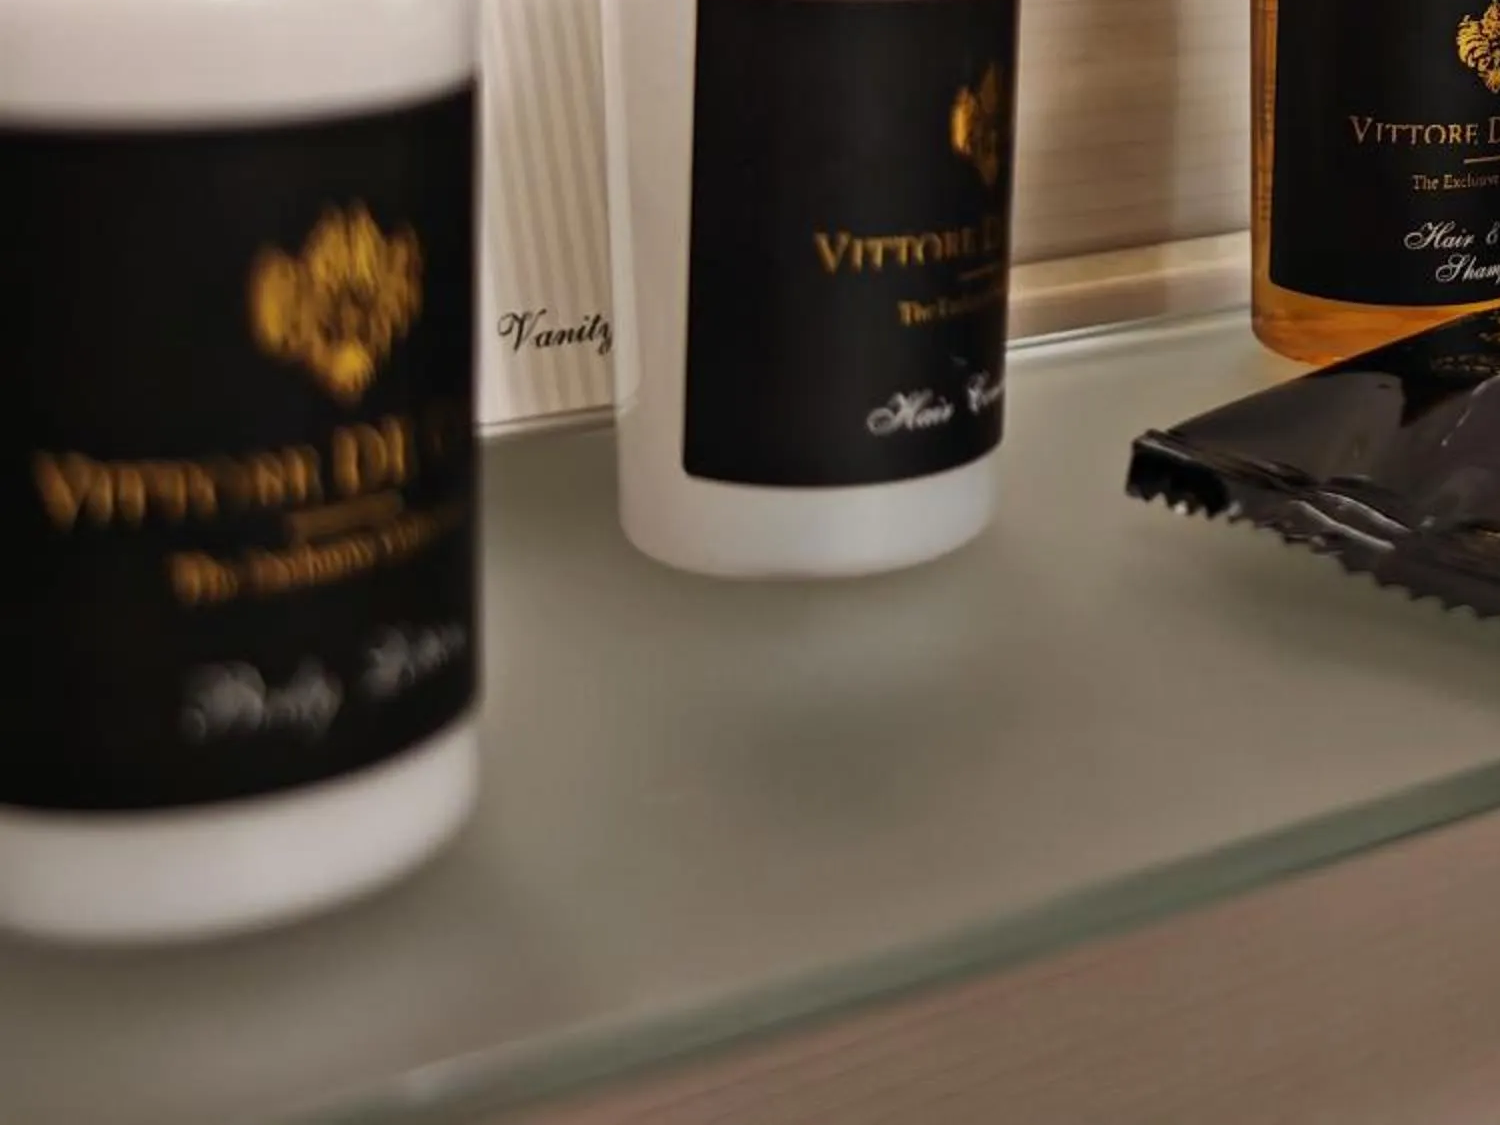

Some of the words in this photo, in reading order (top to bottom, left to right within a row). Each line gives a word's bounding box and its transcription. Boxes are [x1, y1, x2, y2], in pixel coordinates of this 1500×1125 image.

[1348, 115, 1480, 145] VITTORE
[1412, 174, 1439, 190] The
[1403, 221, 1475, 251] Hair
